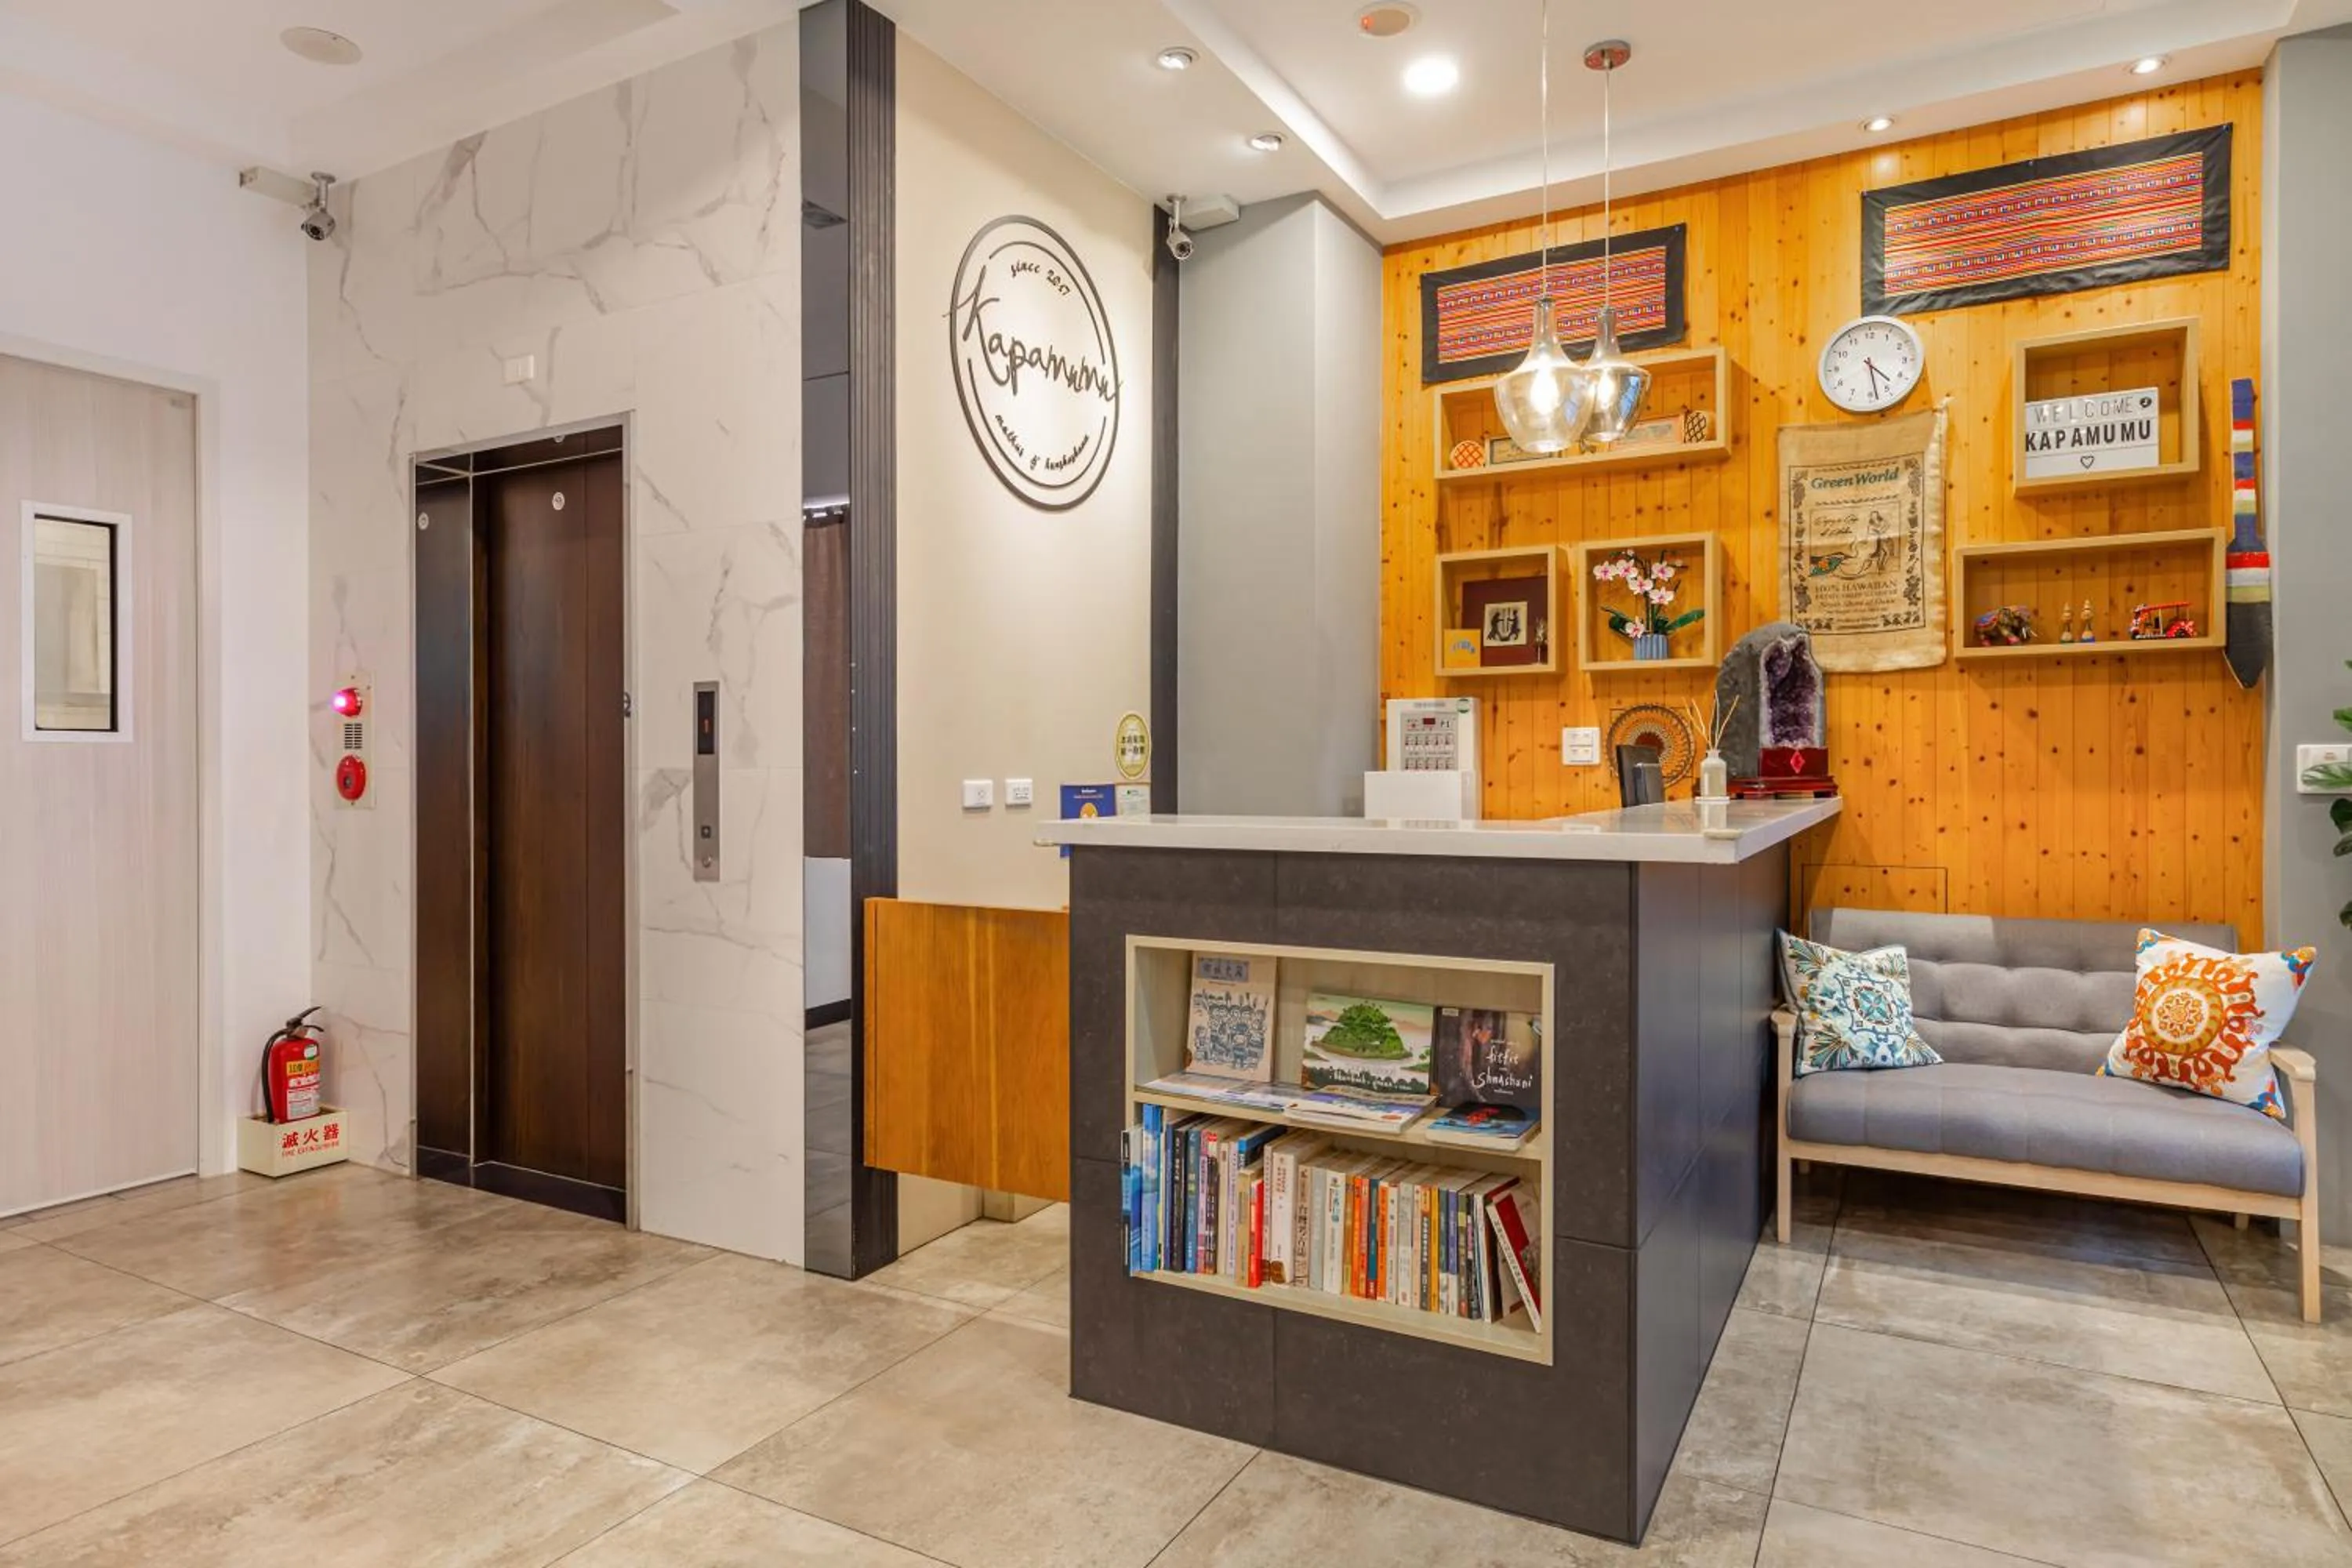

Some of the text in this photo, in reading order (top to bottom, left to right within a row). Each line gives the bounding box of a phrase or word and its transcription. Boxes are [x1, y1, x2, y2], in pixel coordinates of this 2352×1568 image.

[942, 265, 1123, 403] Kapamumu
[2034, 396, 2133, 423] WELCOME
[2025, 419, 2151, 452] KAPAMUMU
[282, 1123, 339, 1149] 滅火器
